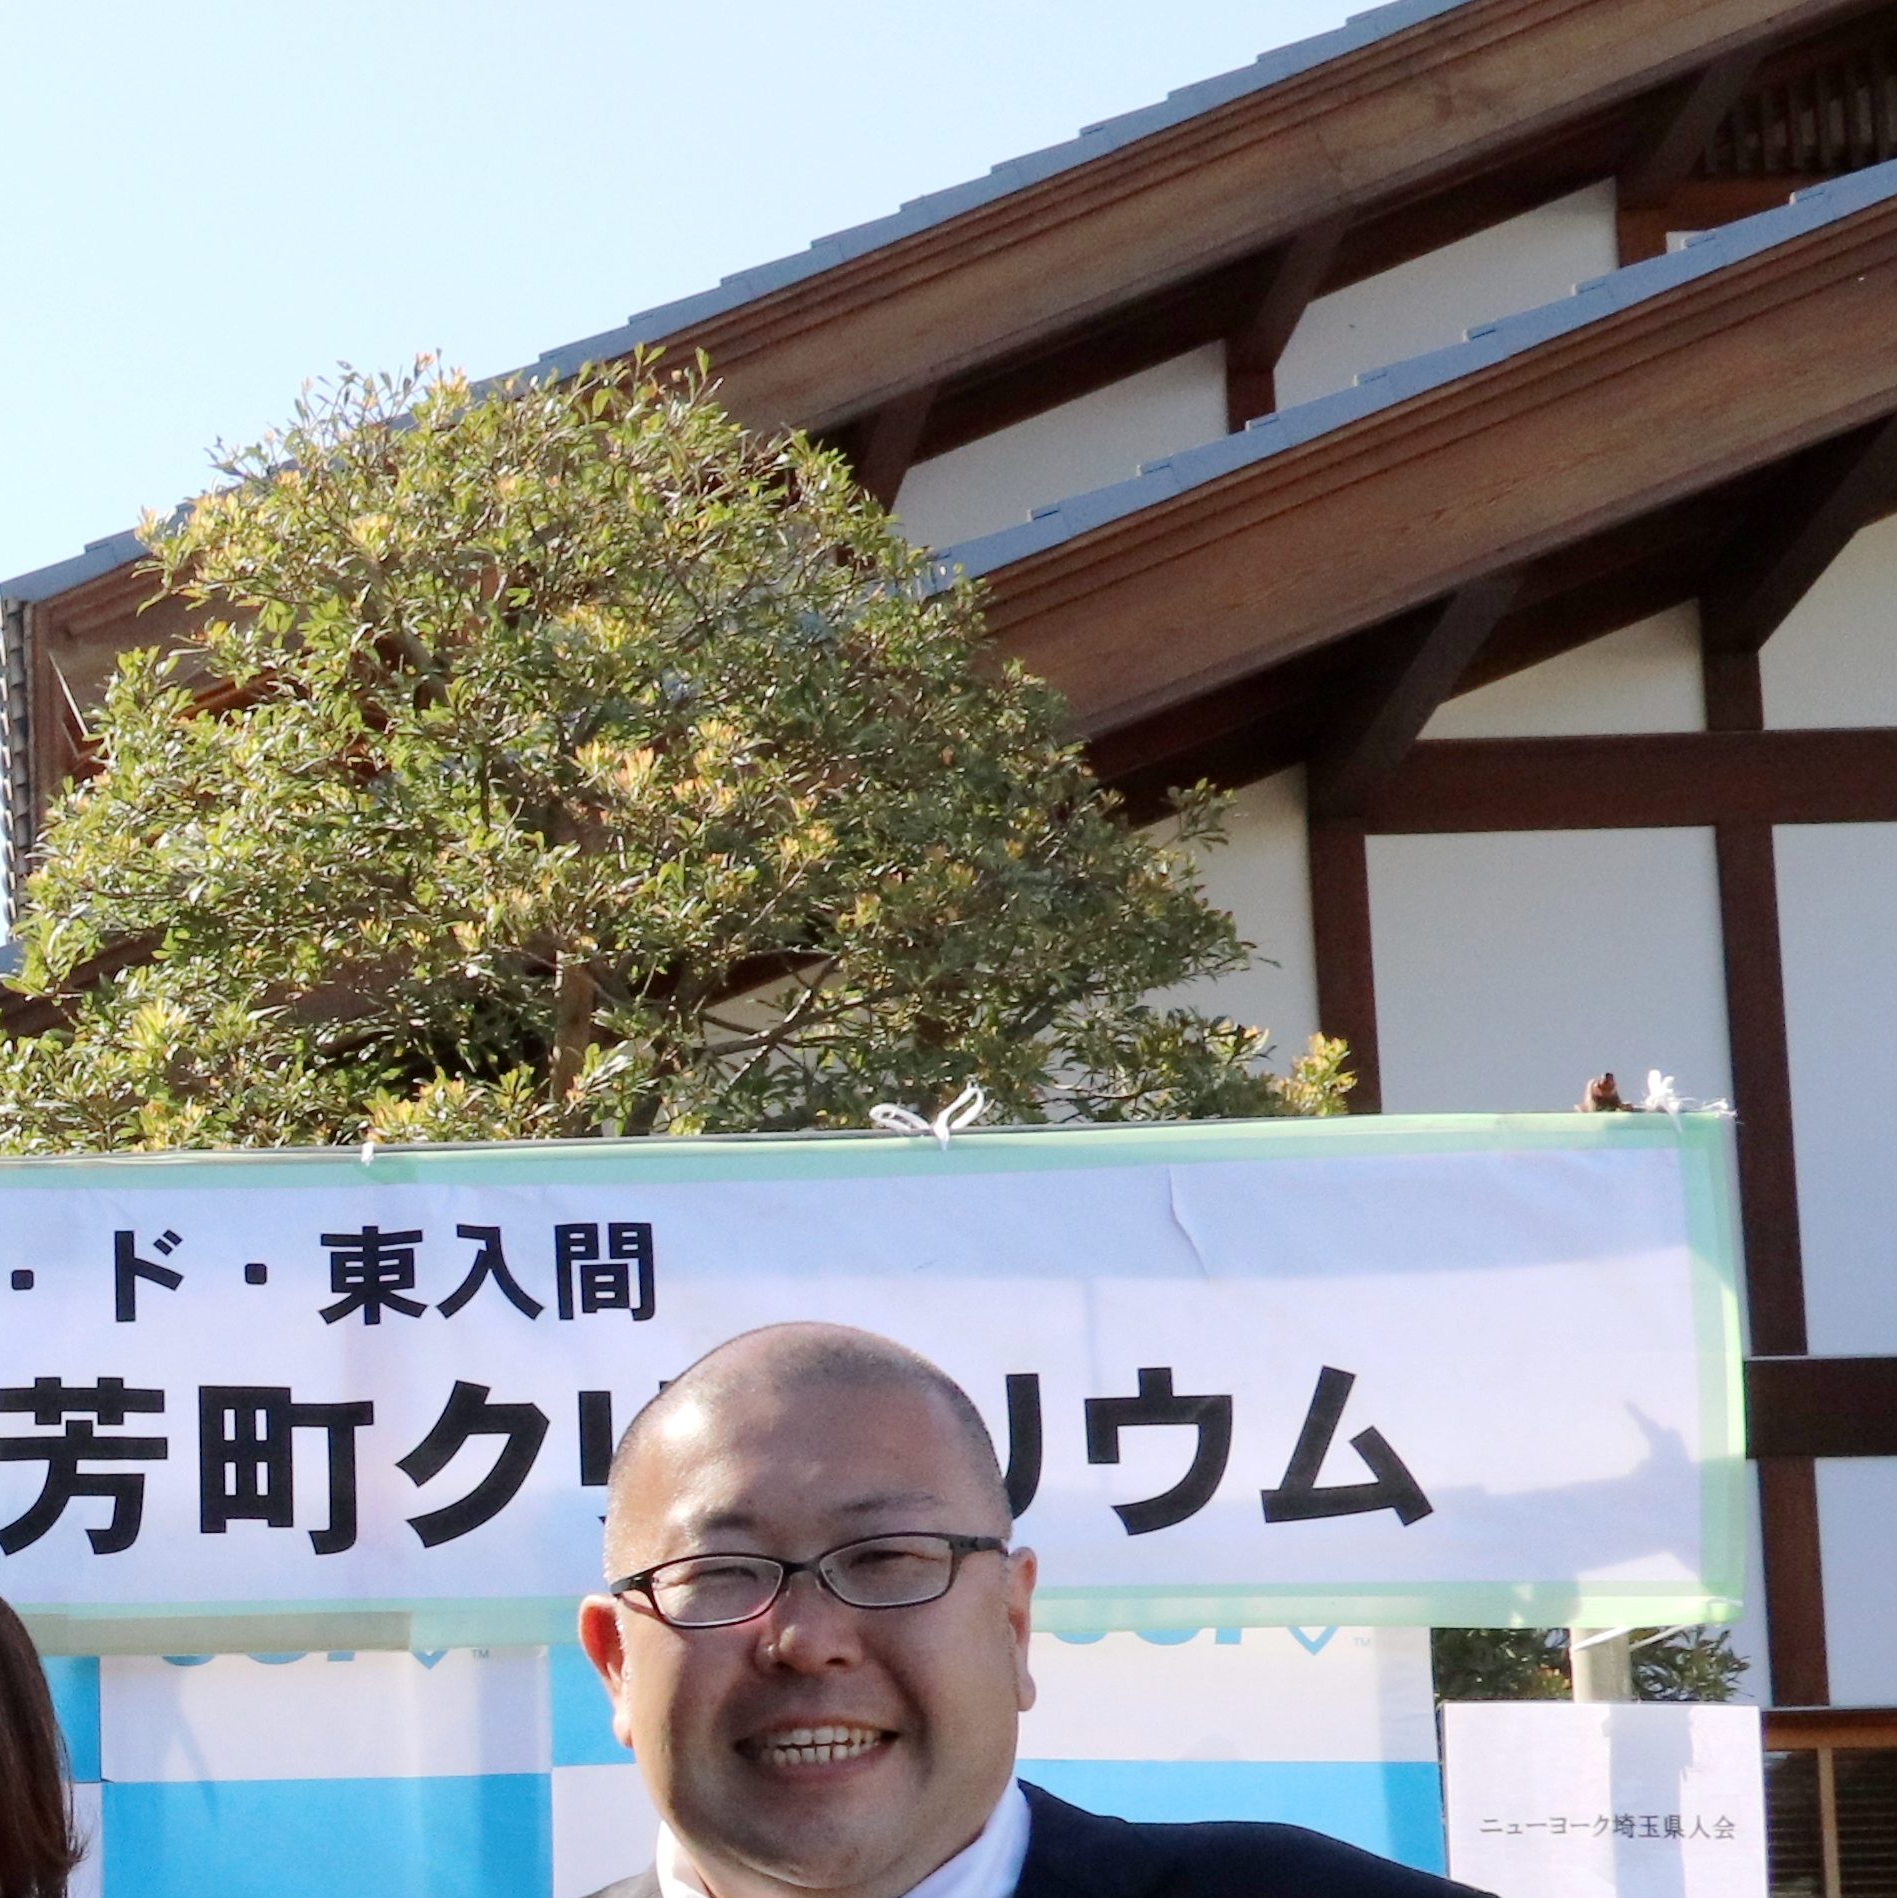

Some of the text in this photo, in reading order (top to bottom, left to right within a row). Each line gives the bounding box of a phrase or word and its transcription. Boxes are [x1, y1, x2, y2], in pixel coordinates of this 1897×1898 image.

[1479, 1813, 1737, 1840] ニューヨーク埼玉県人会
